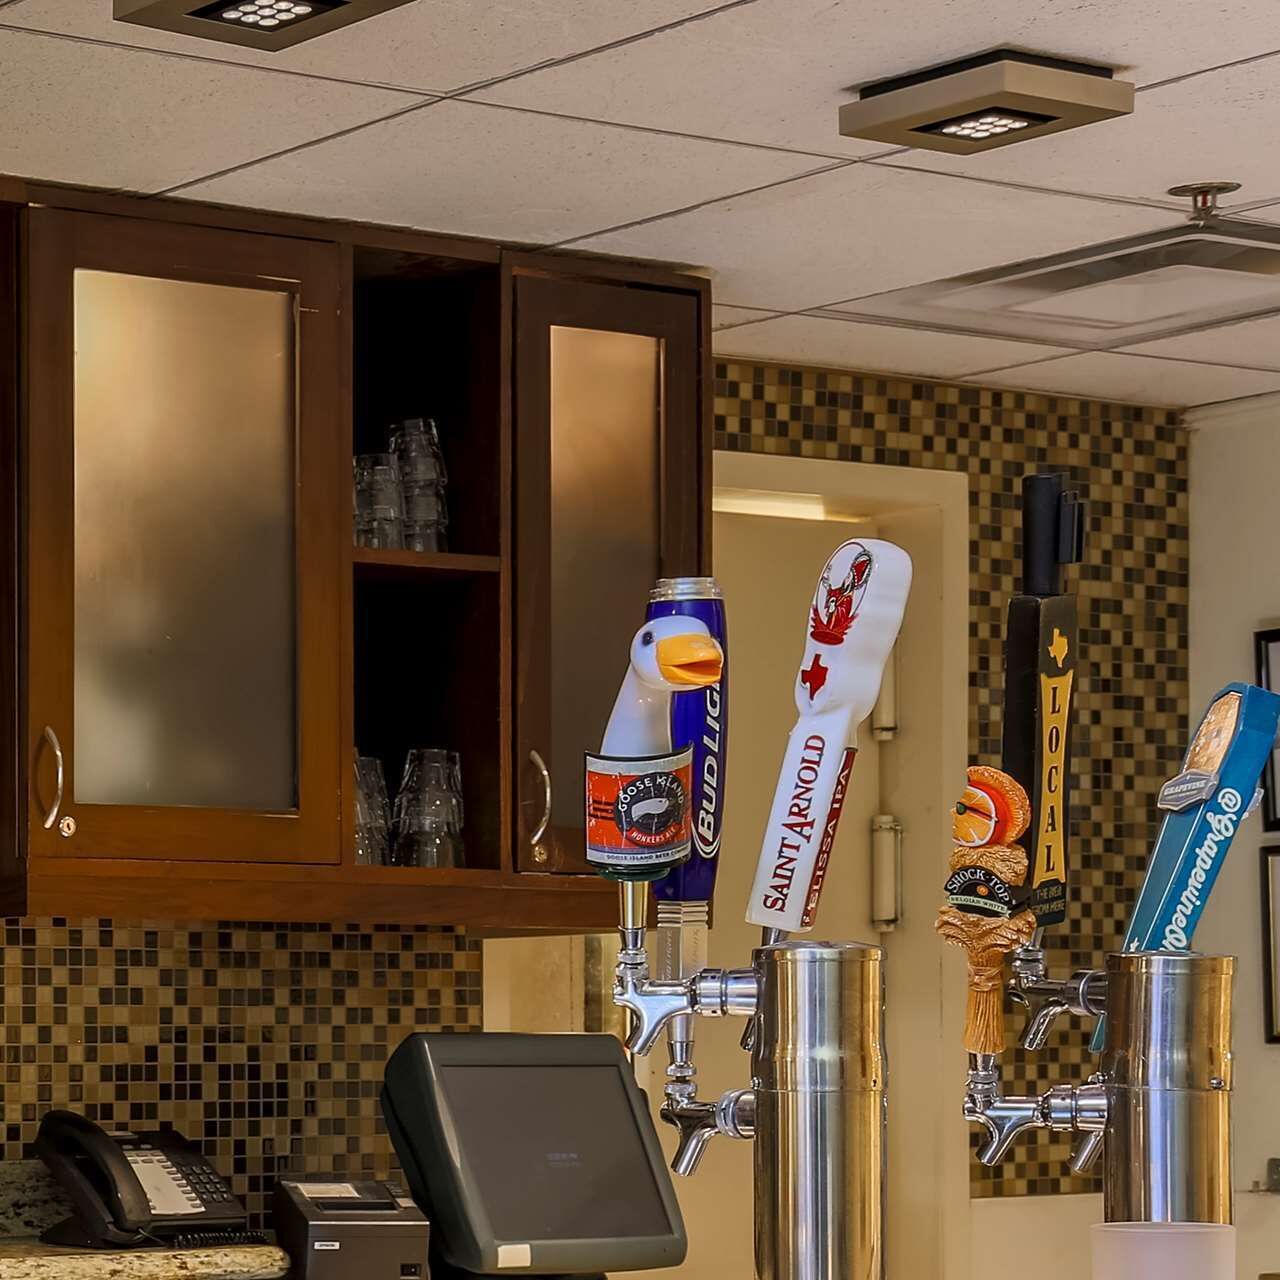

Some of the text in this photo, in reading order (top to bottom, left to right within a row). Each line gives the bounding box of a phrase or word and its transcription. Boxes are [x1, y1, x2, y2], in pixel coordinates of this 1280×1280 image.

[618, 774, 685, 812] GOOSE ISLAND
[698, 683, 721, 842] BUD LIG
[763, 734, 826, 913] SAINT ARNOLD
[1044, 686, 1061, 874] LOCAL
[809, 767, 850, 910] ELISSA IPA
[946, 868, 1010, 902] SHOCK TOP
[982, 900, 1006, 912] WHITE
